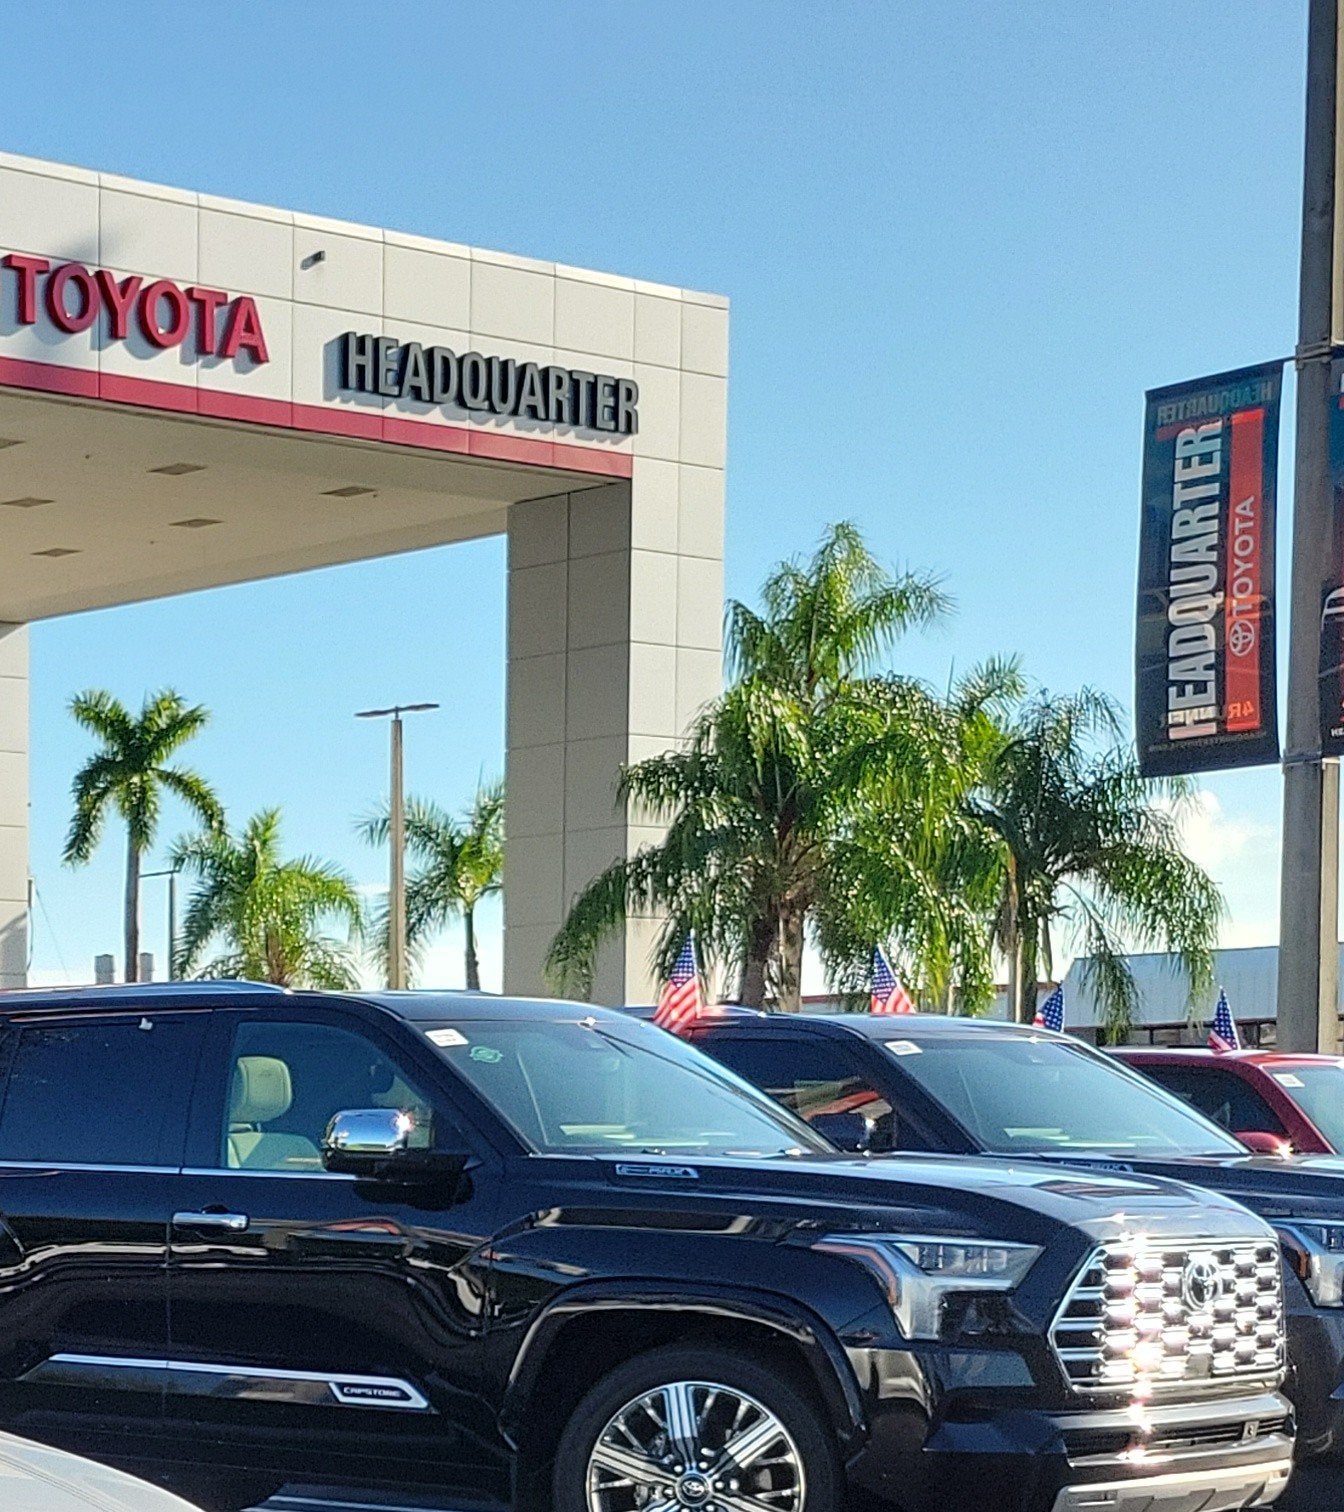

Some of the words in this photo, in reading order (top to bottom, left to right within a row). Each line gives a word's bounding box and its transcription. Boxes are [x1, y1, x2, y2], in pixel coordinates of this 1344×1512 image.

[1, 253, 270, 364] TOYOTA
[340, 331, 639, 434] HEADQUARTER
[1167, 419, 1225, 741] HEADQUARTER
[1232, 496, 1255, 618] TOYOTA
[343, 1386, 402, 1398] CAPSTONE
